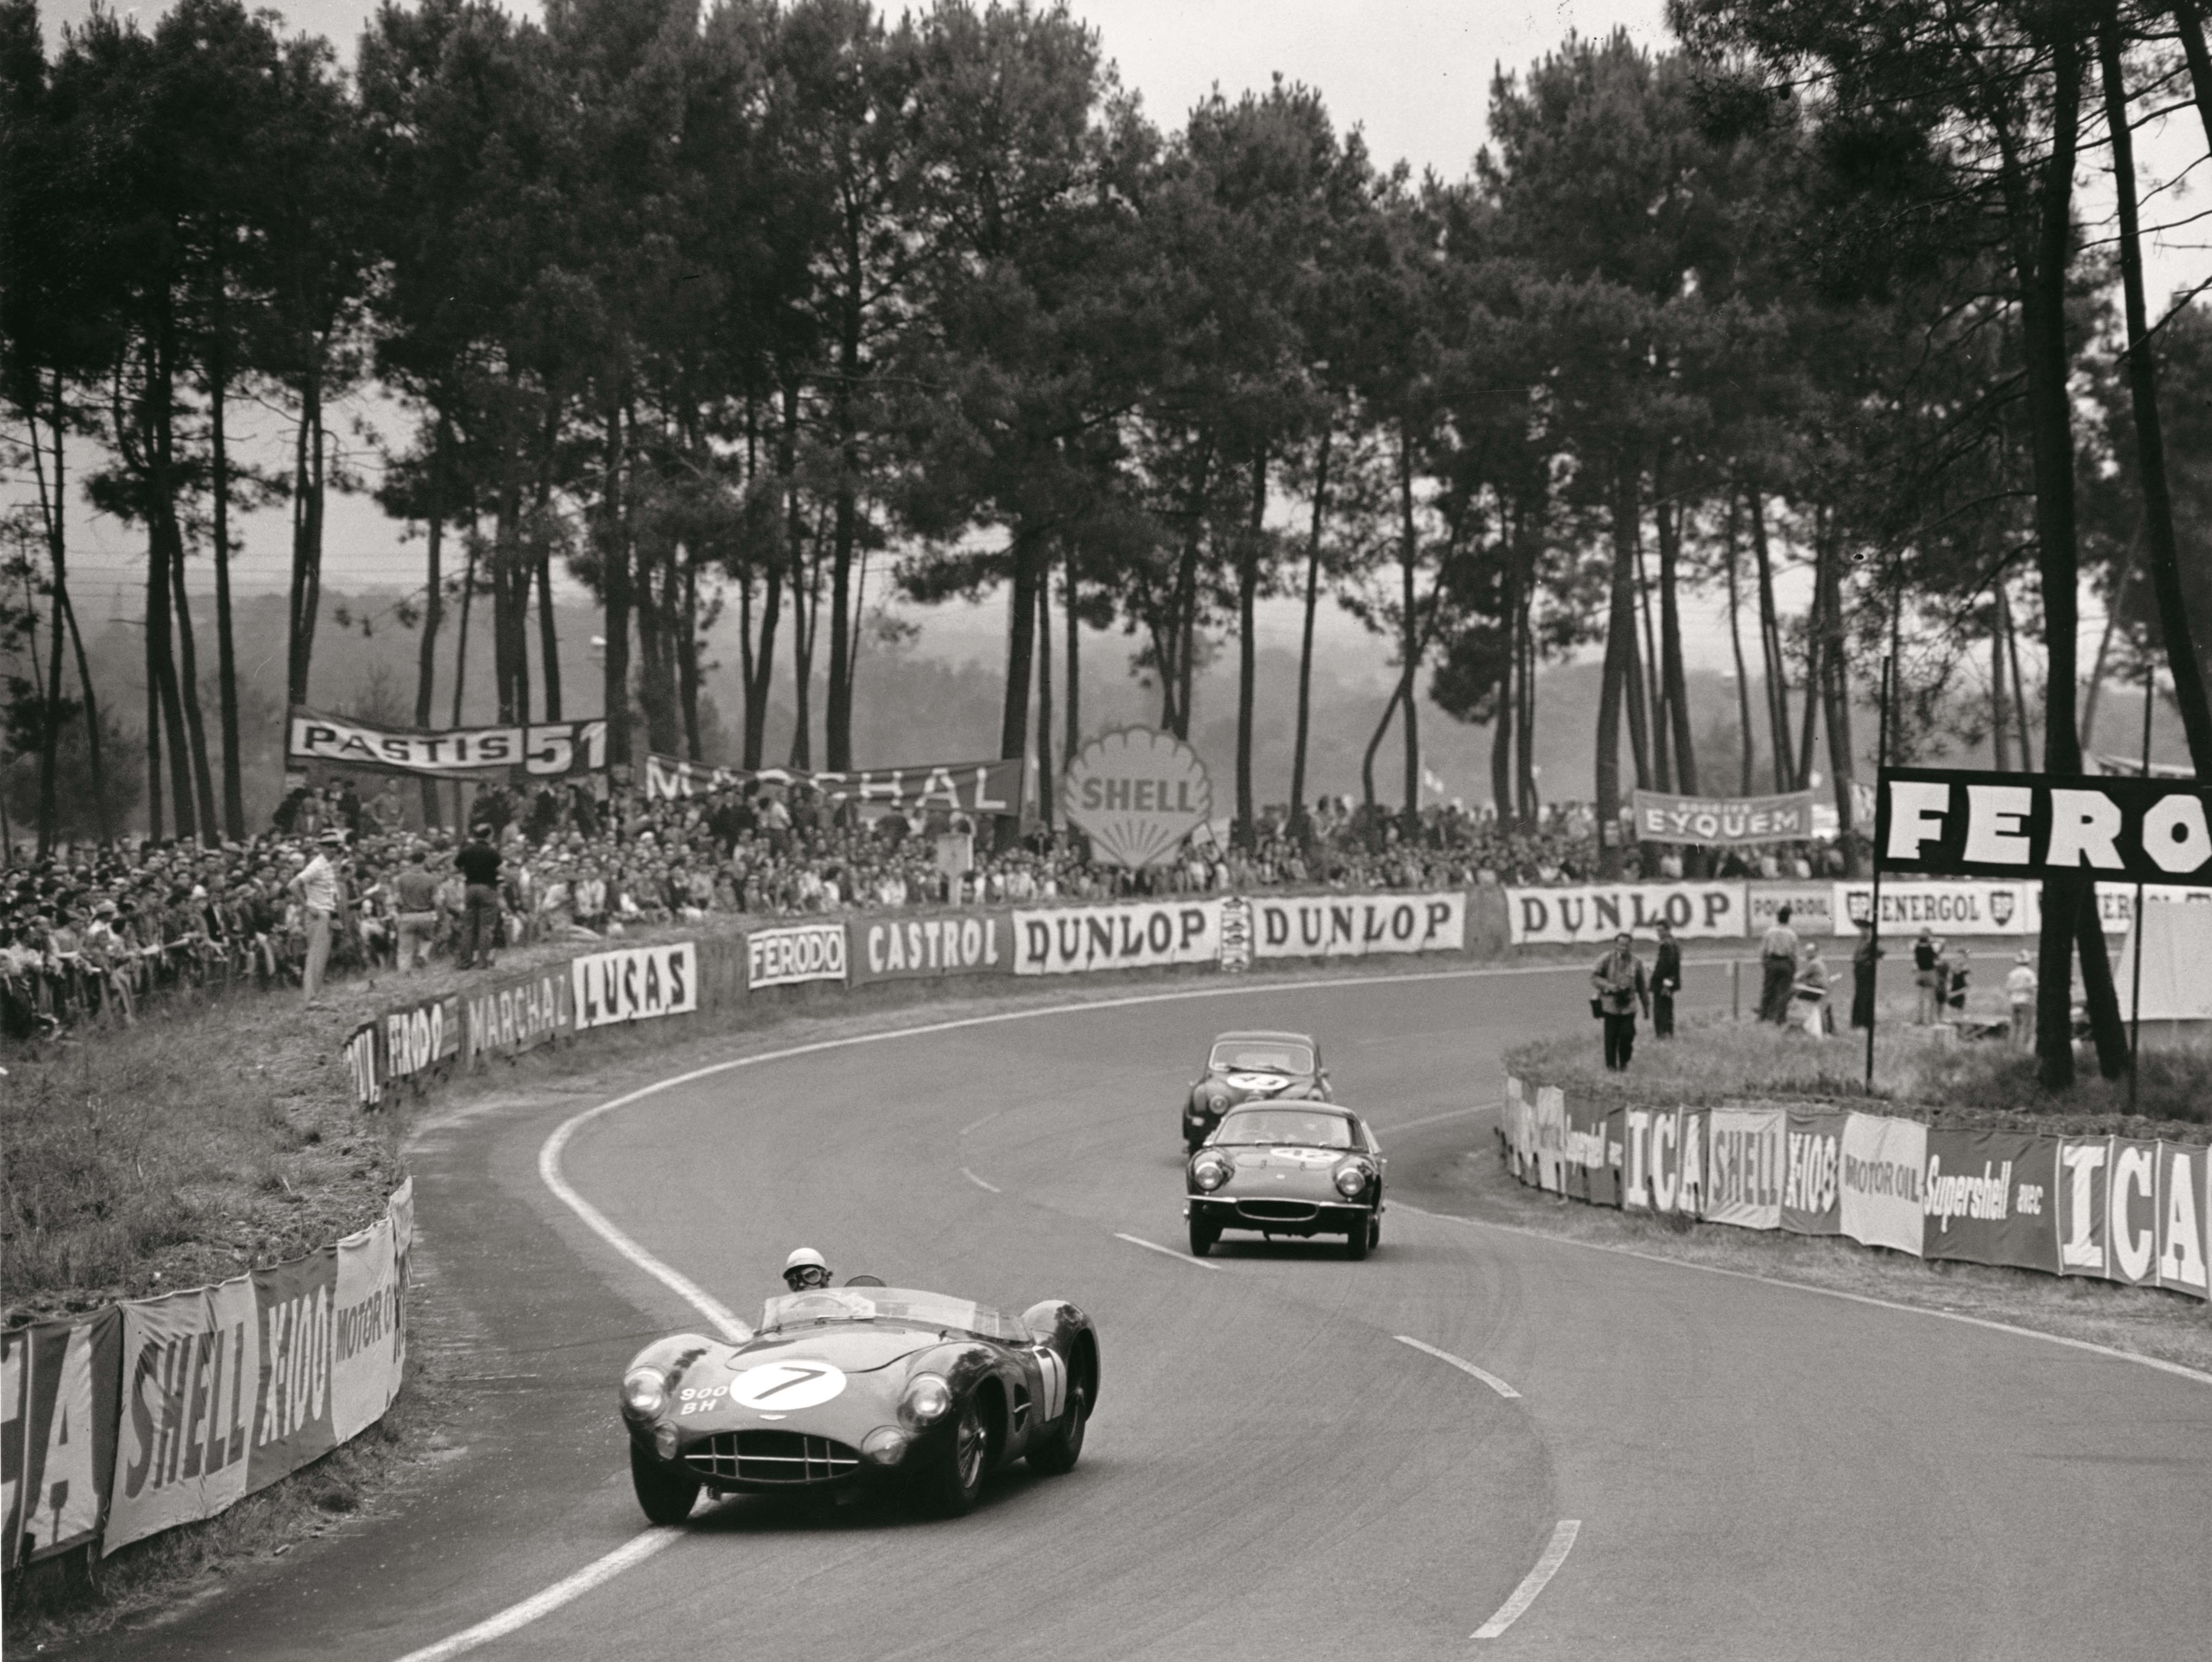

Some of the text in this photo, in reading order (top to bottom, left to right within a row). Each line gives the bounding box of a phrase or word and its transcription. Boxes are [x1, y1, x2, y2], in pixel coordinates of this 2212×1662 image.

[303, 722, 607, 774] PASTIS 51
[1081, 777, 1197, 812] SHELL
[1647, 810, 1799, 838] EYQUEM
[1887, 780, 2212, 873] FERO
[1264, 902, 1451, 945] DUNLOP
[1520, 893, 1730, 932] DUNLOP
[1882, 895, 1980, 921] ENERGOL
[750, 933, 844, 979] FERODO
[868, 919, 999, 973] CASTROL
[1025, 909, 1206, 962] DUNLOP
[583, 951, 686, 1020] LUCAS
[468, 975, 567, 1056] MARCHAL
[1628, 1112, 1705, 1213] ICA
[1714, 1130, 1779, 1205] SHELL
[1845, 1154, 1893, 1196] MOTOR
[1896, 1164, 1920, 1203] OIL
[1924, 1145, 2206, 1288] Supershell avec ICA
[125, 1321, 245, 1499] SHELL
[335, 1290, 382, 1363] MOTOR
[679, 1385, 728, 1401] 900
[680, 1398, 717, 1415] BH
[752, 1366, 828, 1400] 7
